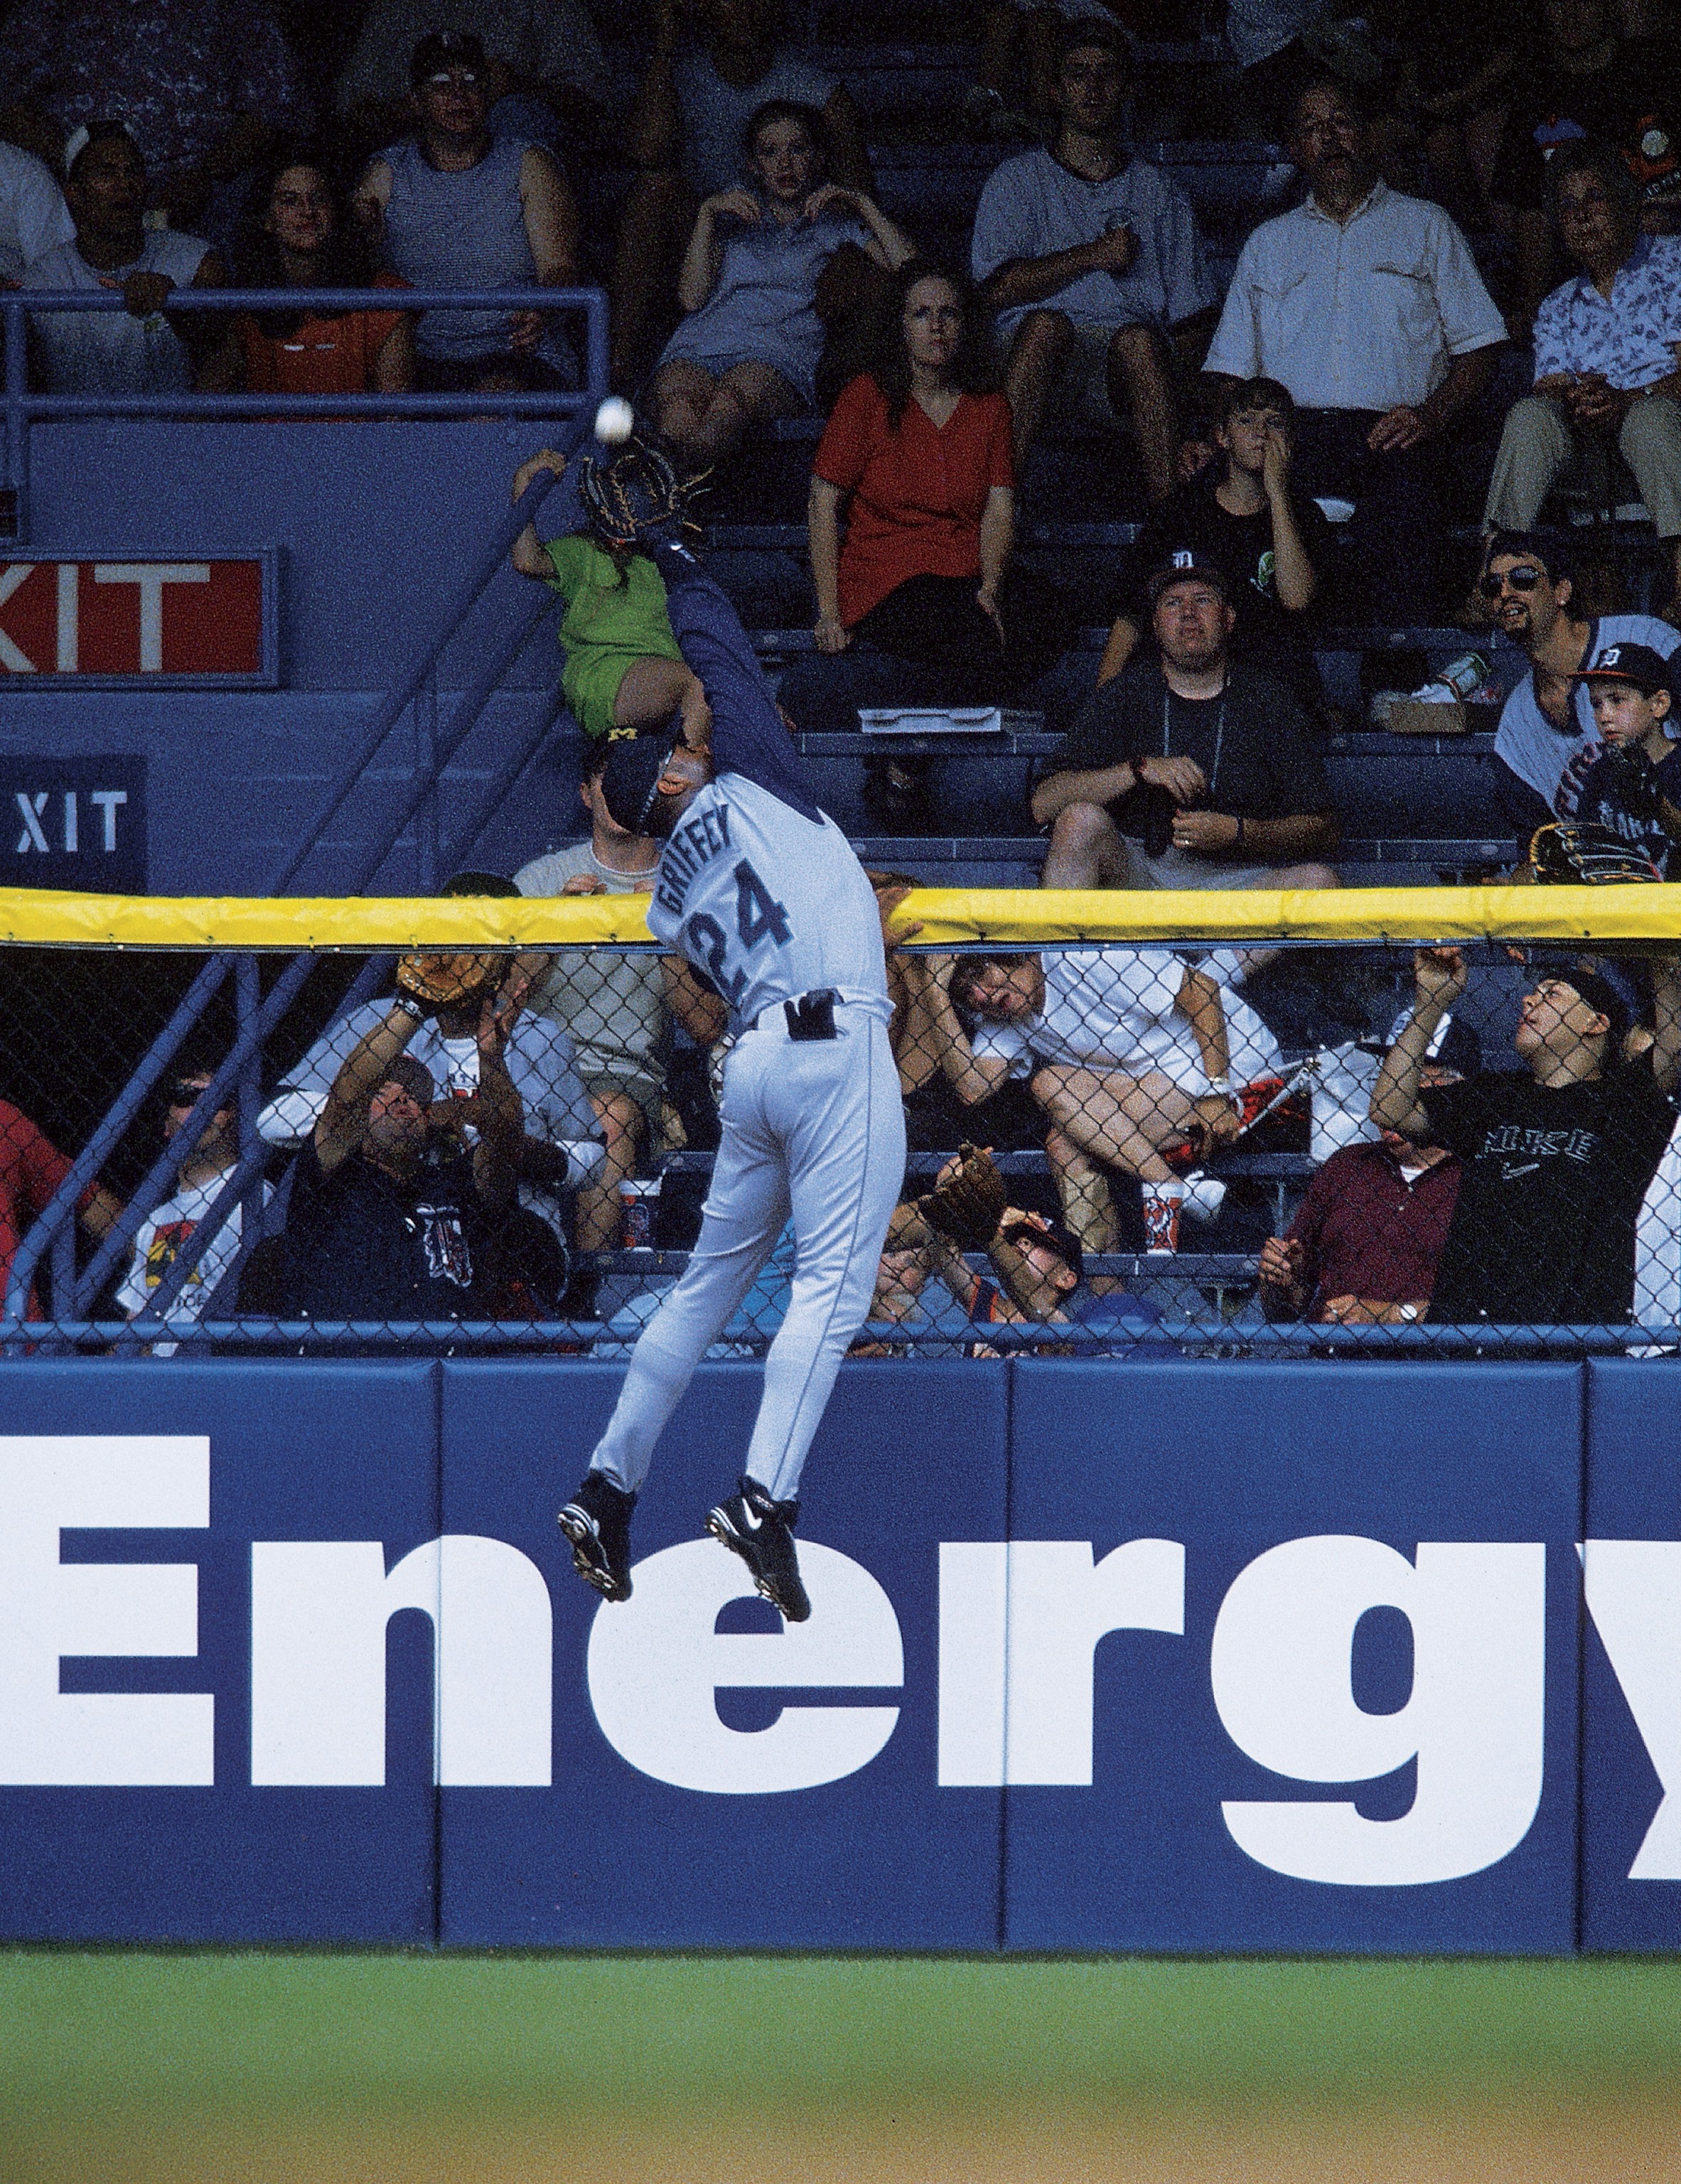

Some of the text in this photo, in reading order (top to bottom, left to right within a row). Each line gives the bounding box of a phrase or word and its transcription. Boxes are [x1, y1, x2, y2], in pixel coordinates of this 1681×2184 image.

[608, 728, 638, 742] M
[14, 791, 128, 853] XIT
[657, 804, 731, 917] GRIFFEY
[685, 856, 795, 1009] 24
